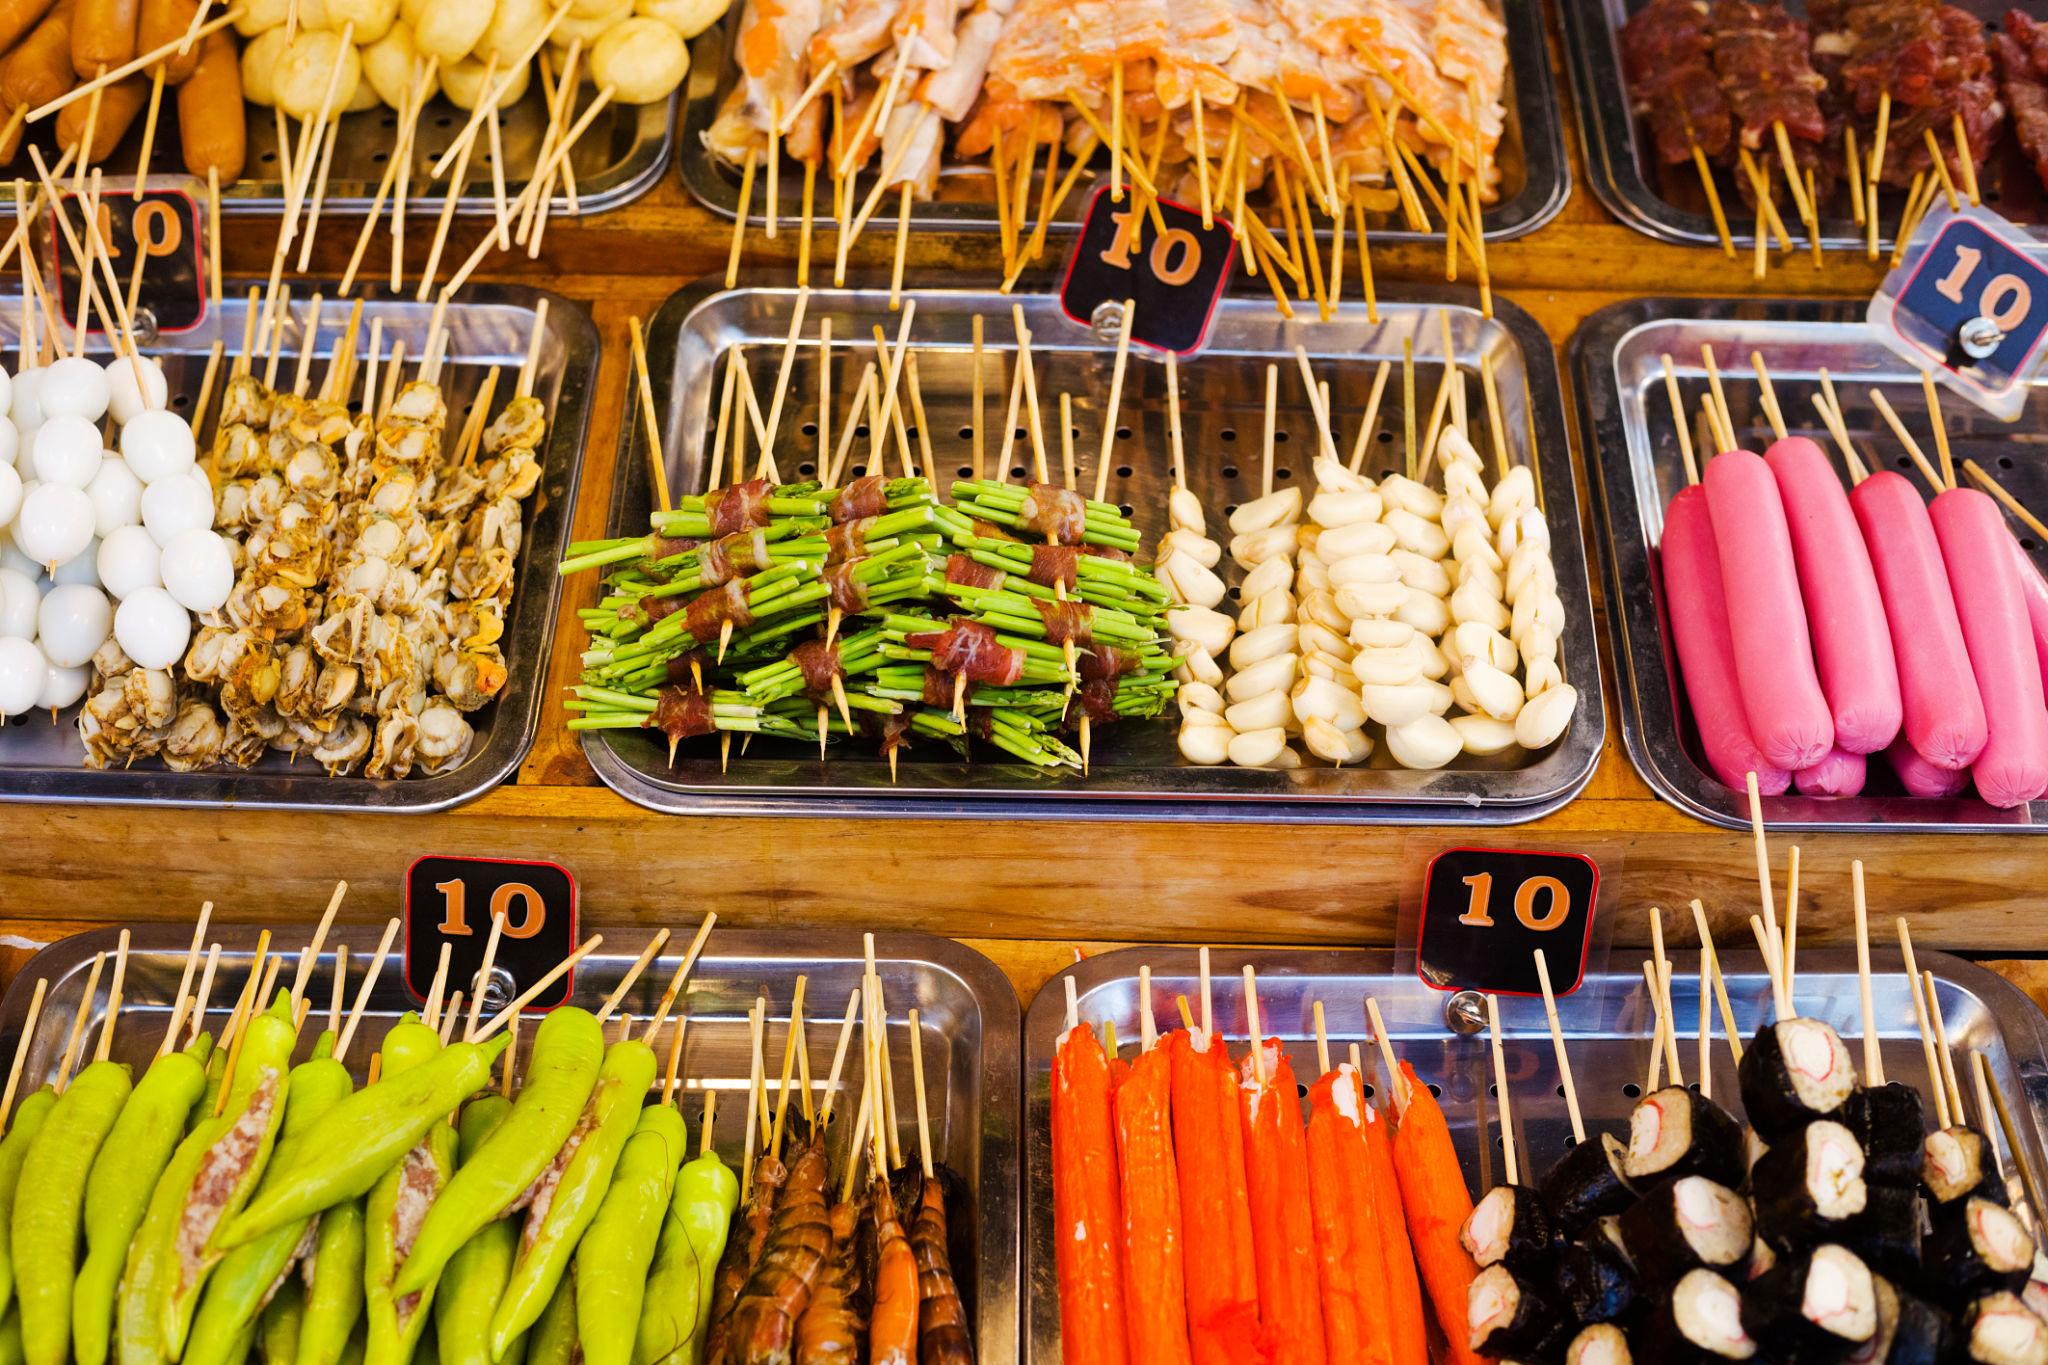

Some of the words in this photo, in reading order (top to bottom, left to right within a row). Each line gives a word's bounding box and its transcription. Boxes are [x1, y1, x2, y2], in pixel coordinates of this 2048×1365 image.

[1100, 211, 1202, 287] 10
[1935, 244, 2032, 332] 10
[435, 878, 546, 939] 10
[1458, 871, 1571, 931] 10
